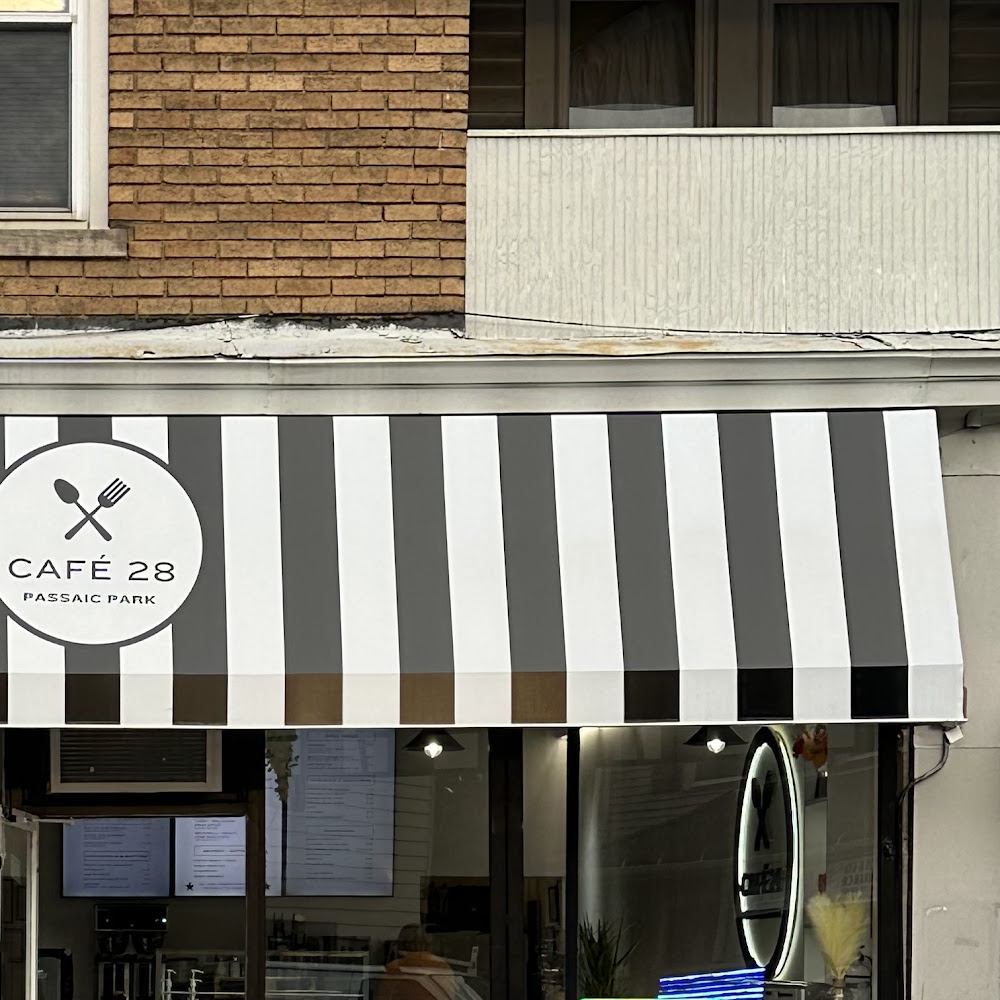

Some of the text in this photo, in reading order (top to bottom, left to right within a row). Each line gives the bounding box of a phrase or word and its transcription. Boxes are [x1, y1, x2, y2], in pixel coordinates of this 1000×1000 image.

[8, 554, 175, 582] CAFÉ 28
[23, 592, 156, 605] PASSAIC PARK
